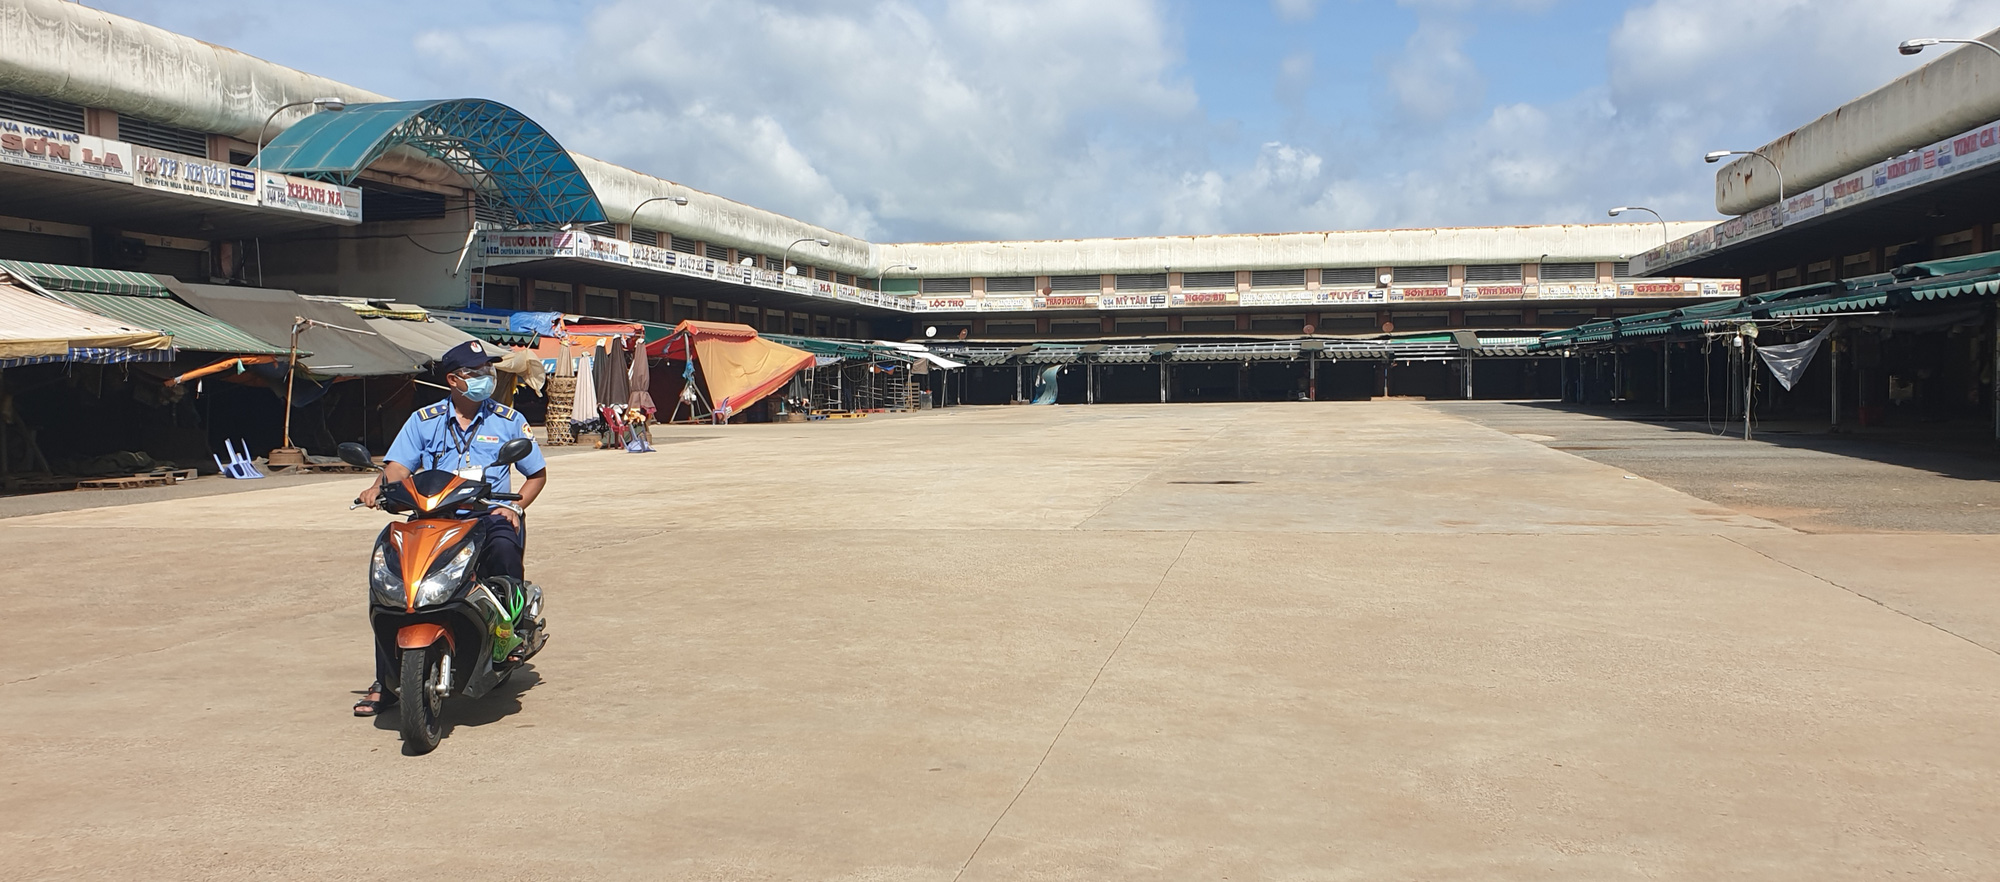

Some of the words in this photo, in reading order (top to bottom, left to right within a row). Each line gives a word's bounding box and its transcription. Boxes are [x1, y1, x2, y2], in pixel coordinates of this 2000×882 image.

[24, 126, 60, 140] KHOAI
[1, 134, 71, 160] SƠN
[82, 148, 122, 169] LA
[170, 181, 182, 189] MUA
[286, 182, 325, 204] KHANH
[327, 190, 343, 207] NA
[1330, 290, 1366, 300] TUYẾT
